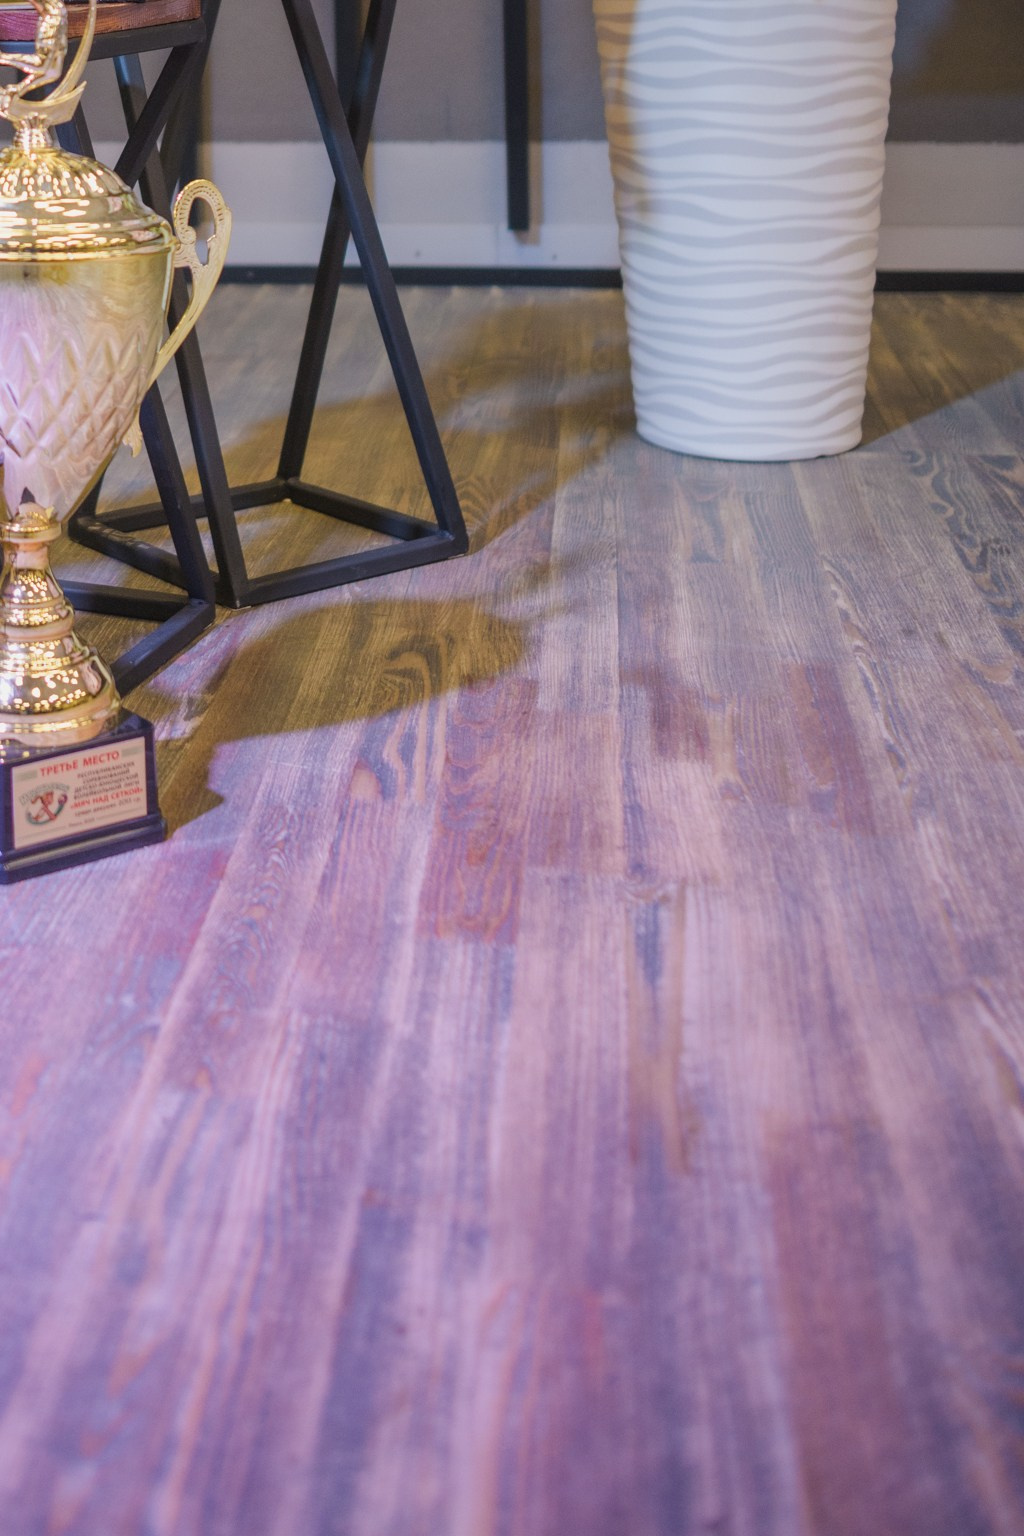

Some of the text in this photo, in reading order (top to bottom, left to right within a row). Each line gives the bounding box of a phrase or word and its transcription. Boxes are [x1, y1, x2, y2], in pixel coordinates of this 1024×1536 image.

[39, 750, 120, 777] ТРЕТЬЕ МЕСТО
[92, 795, 110, 805] НАД
